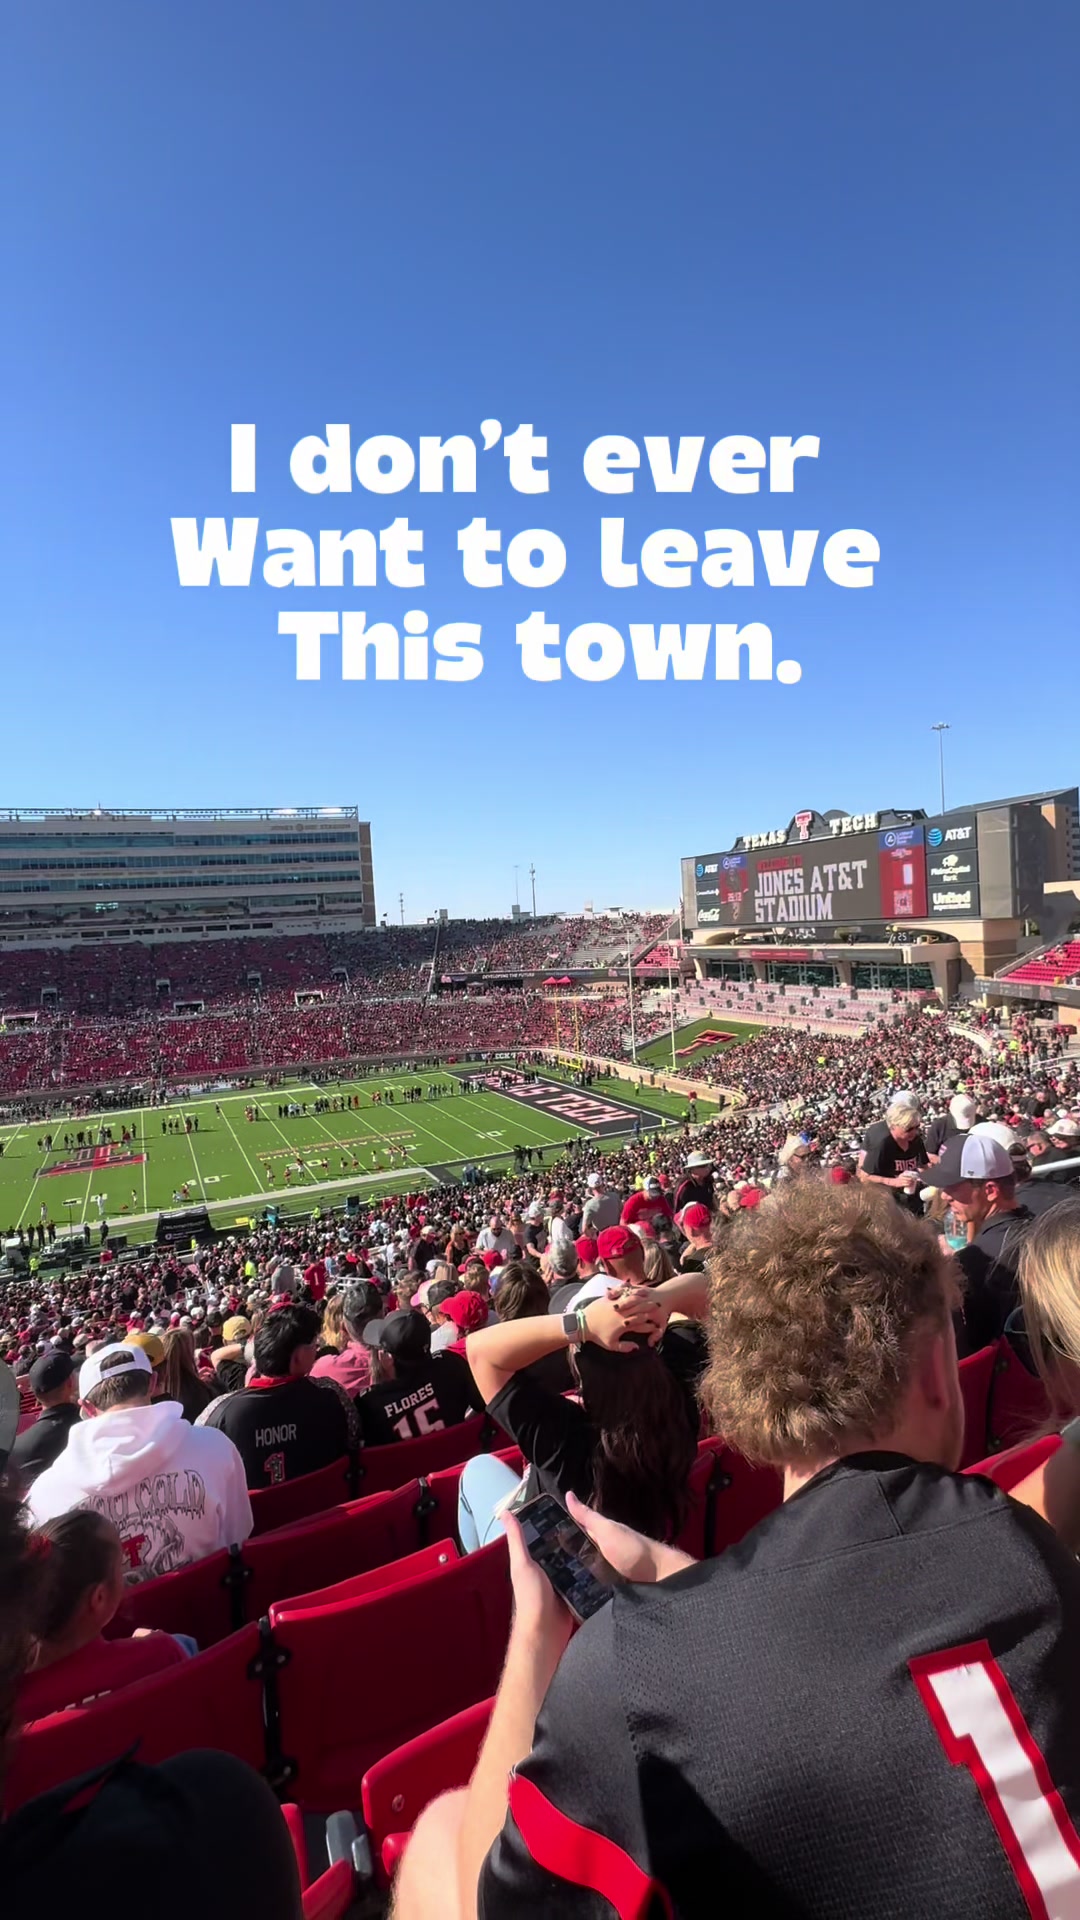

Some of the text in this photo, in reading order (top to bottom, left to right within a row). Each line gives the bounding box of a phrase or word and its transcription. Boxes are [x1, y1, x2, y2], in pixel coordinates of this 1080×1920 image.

[743, 830, 786, 849] TEXAS
[829, 815, 878, 835] TECH
[944, 826, 972, 842] AT&T
[754, 860, 868, 893] JONES AT&T
[754, 892, 833, 923] STADIUM
[534, 1093, 640, 1125] TECH
[384, 1382, 435, 1418] FLORES
[255, 1423, 298, 1447] HONOR
[393, 1397, 446, 1440] 15
[263, 1451, 286, 1484] 1
[134, 1468, 206, 1521] COLD
[907, 1638, 1080, 1920] 1
